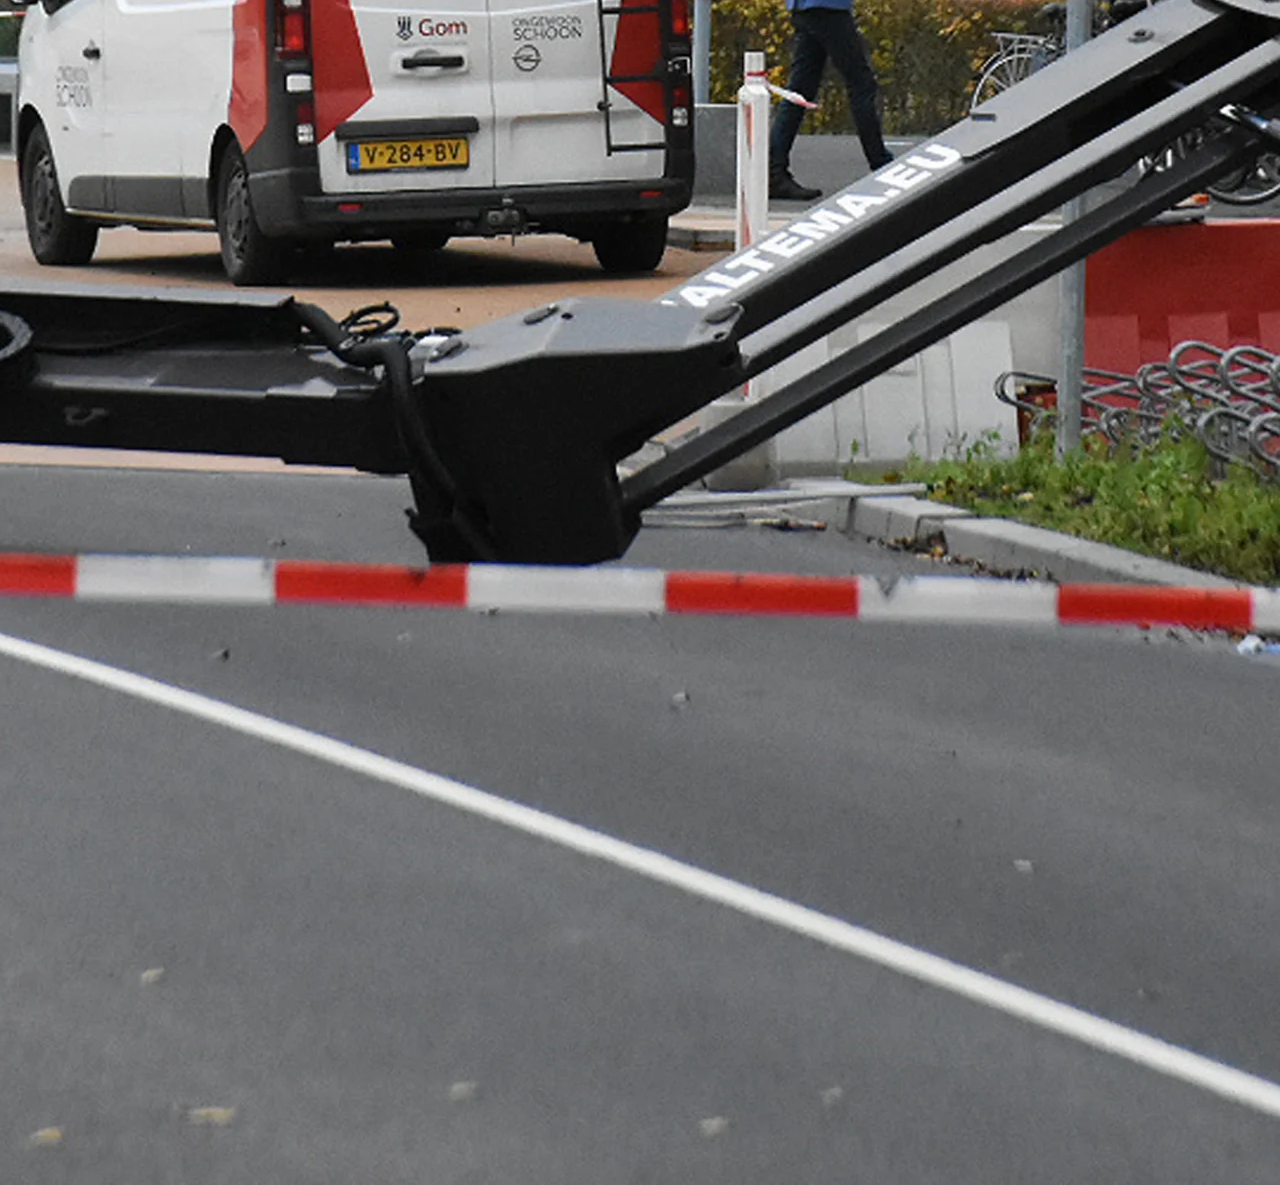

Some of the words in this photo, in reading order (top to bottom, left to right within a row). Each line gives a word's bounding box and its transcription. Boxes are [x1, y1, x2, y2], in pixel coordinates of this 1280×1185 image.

[418, 18, 468, 37] Gom
[512, 15, 582, 28] ONGEWOON
[513, 25, 582, 41] SCHOON
[364, 142, 461, 164] V-284-BV
[660, 143, 962, 308] ALTEMA.EU
